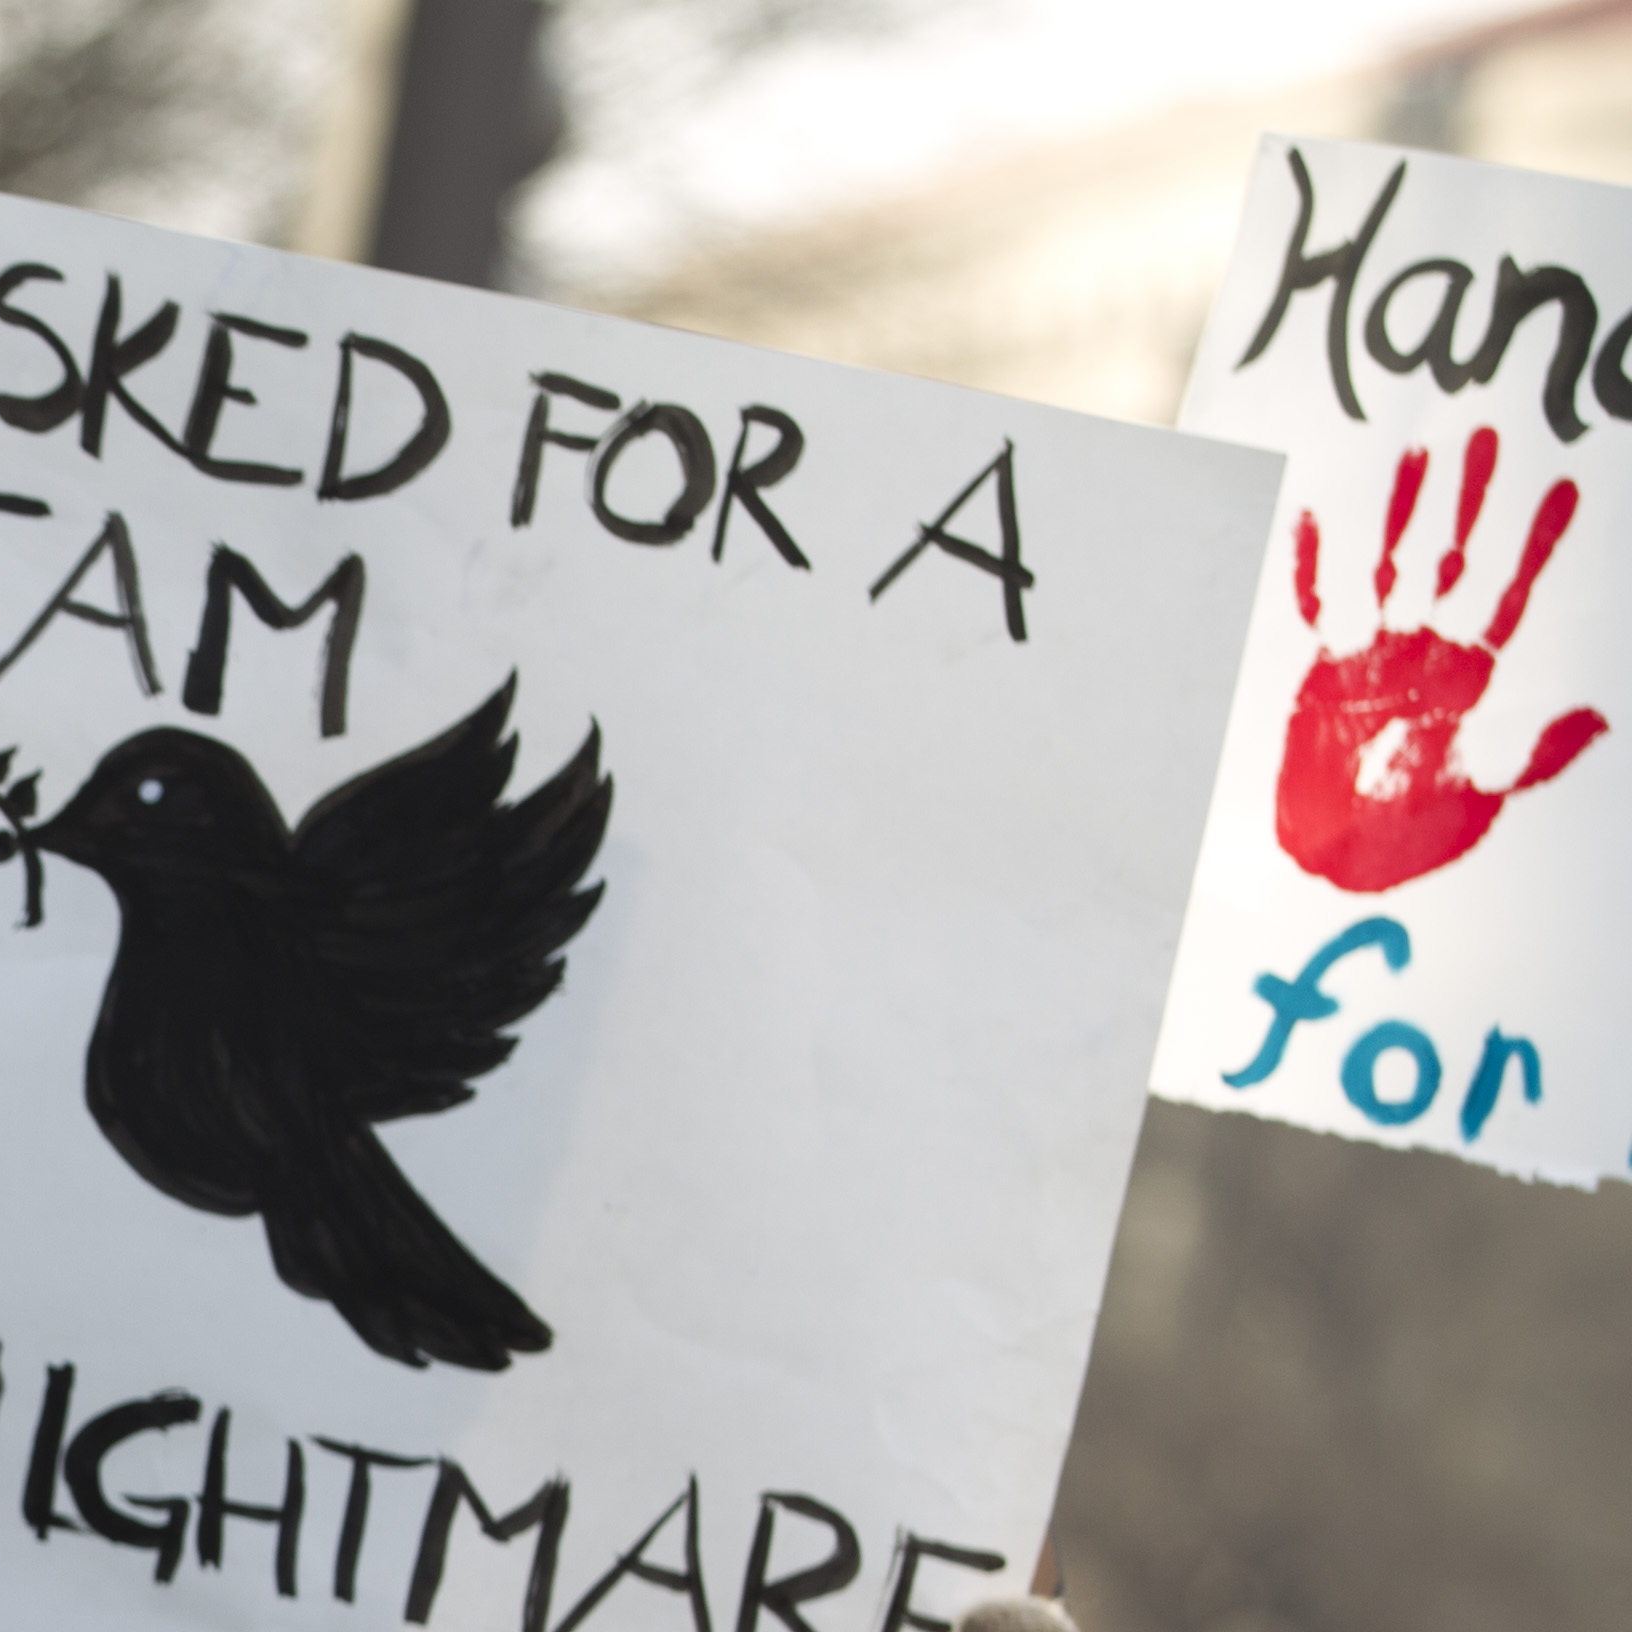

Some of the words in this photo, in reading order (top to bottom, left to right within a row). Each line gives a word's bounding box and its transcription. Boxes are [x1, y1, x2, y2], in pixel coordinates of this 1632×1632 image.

[510, 371, 811, 571] FOR
[869, 437, 1034, 643] A
[1221, 915, 1544, 1147] for
